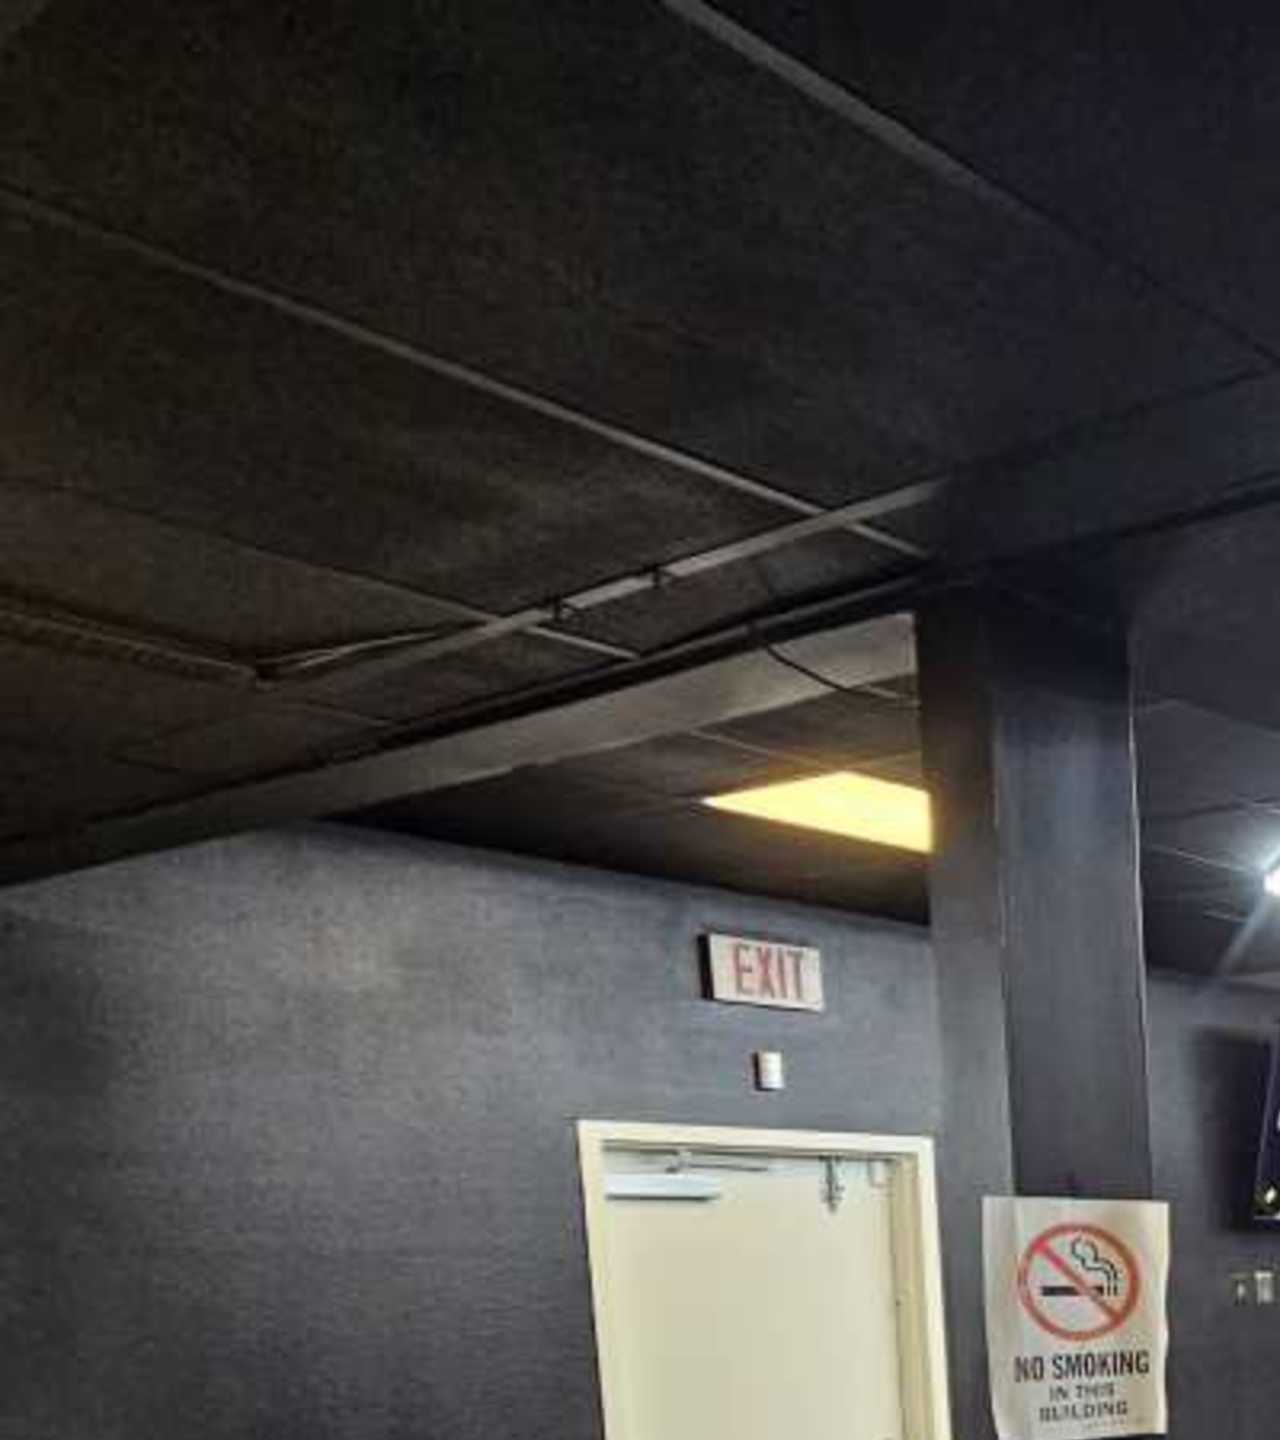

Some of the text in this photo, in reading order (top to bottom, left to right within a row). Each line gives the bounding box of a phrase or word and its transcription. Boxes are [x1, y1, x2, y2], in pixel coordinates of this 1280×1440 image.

[732, 943, 805, 1000] EXIT
[1014, 1349, 1150, 1382] NO SMOKING
[1049, 1382, 1116, 1400] IN THIS
[1039, 1400, 1128, 1421] BUILDING
